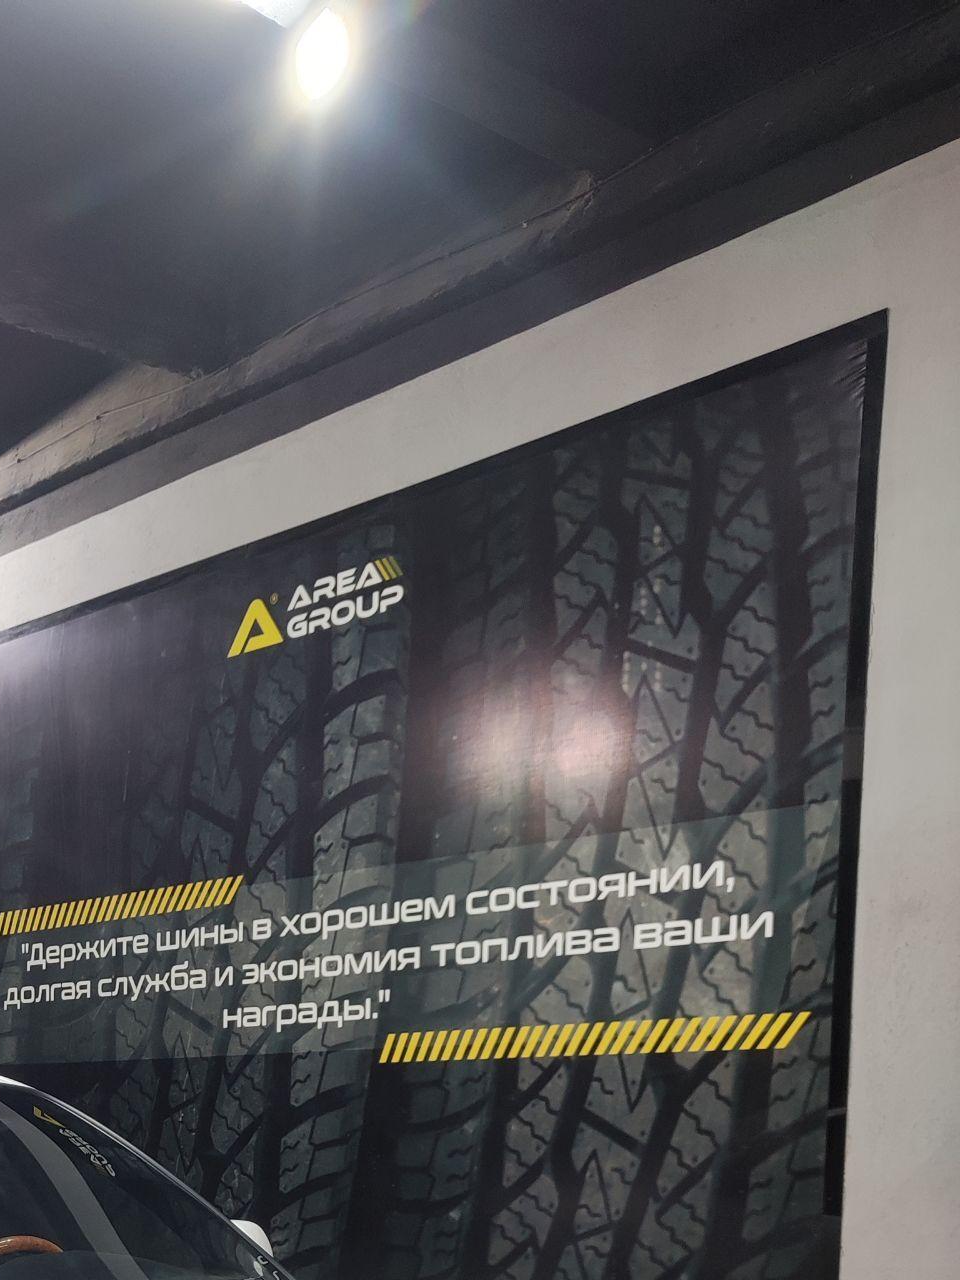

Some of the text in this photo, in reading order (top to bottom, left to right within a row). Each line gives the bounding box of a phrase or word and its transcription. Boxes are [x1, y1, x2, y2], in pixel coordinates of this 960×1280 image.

[286, 584, 405, 639] GROUP
[287, 562, 383, 612] AREA
[21, 860, 736, 972] "Держите шины в хорошем состоянии,
[3, 910, 774, 1011] долгая служба и экономия топлива ваши
[222, 988, 391, 1033] награды."
